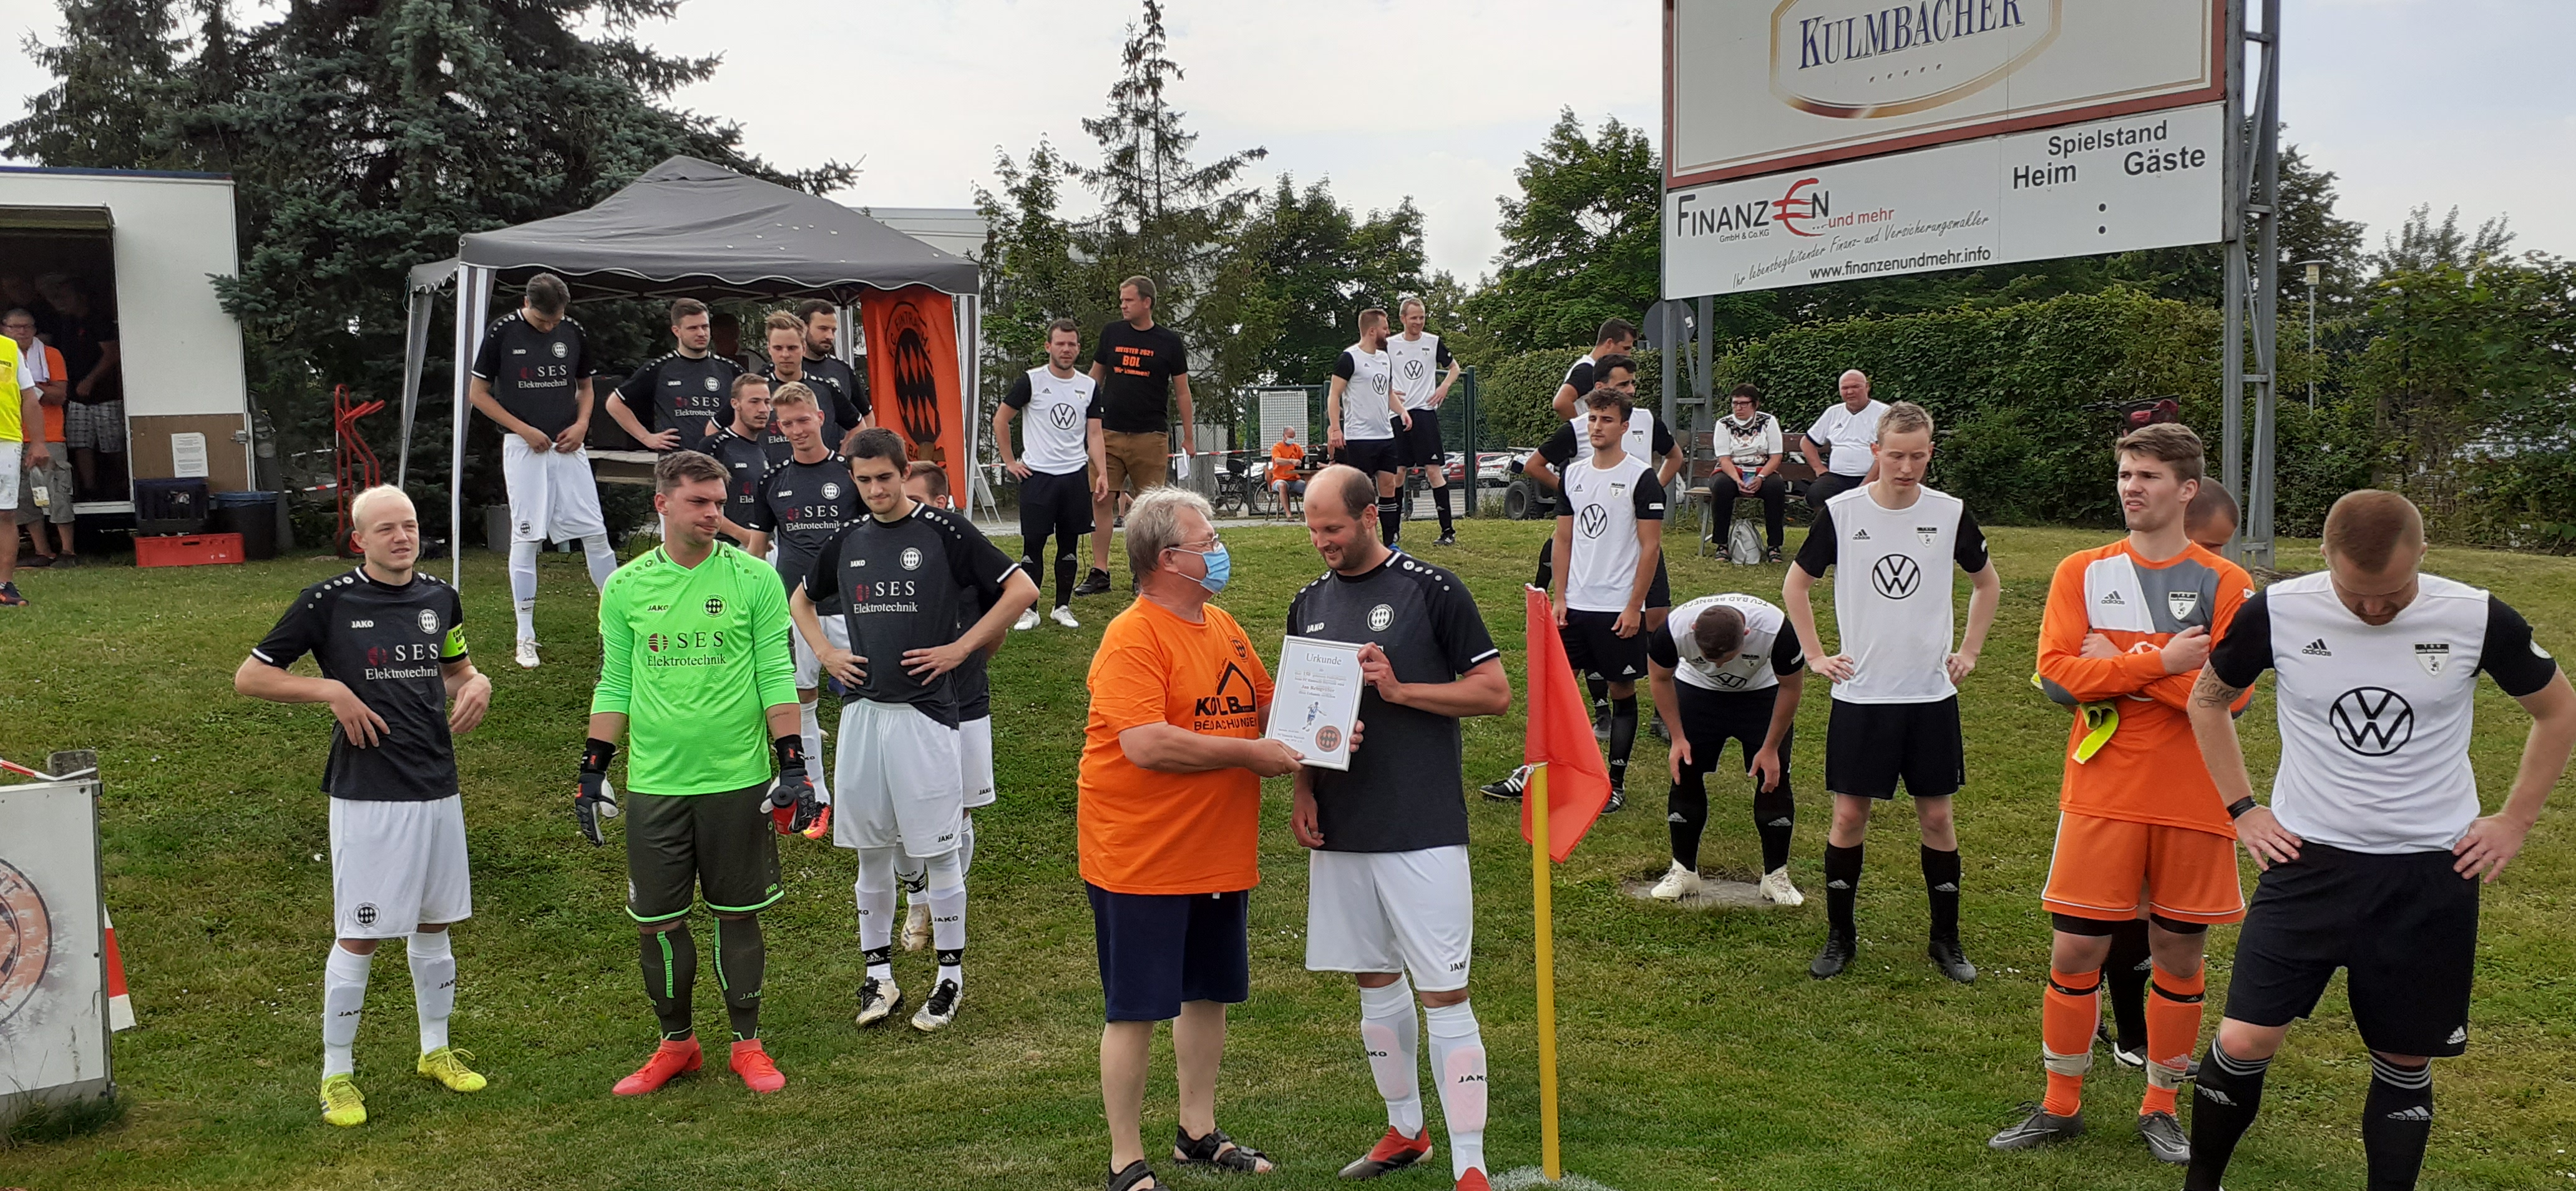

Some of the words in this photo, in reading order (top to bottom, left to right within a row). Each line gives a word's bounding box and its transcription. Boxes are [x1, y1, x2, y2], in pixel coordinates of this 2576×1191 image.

[1798, 0, 2026, 71] KULMBACHER
[2047, 119, 2168, 159] Spielstand
[2013, 161, 2077, 190] Heim
[2124, 145, 2206, 176] Gäste
[1857, 207, 1895, 224] mehr
[1719, 231, 1740, 243] GmbH
[1732, 273, 1746, 292] Ihr
[1749, 241, 1826, 281] lebensbegleitender
[1830, 236, 1861, 253] Finanz-
[1864, 231, 1880, 245] und
[1884, 209, 1990, 242] Versicherungsmakler
[1810, 246, 1991, 280] www.finanzenundmehr.info
[1139, 348, 1154, 357] 2021
[1122, 355, 1141, 367] BOL
[778, 490, 793, 498] JAKO
[850, 559, 866, 567] JAKO
[853, 601, 919, 614] Elektrotechnik
[351, 620, 374, 629] JAKO
[1305, 622, 1325, 634] JAKO
[1305, 652, 1342, 666] Urkunde
[2301, 647, 2332, 657] adidas
[647, 653, 728, 667] Elektrotechnik
[364, 665, 438, 680] Elektrotechni
[1194, 696, 1239, 717] KOLB
[1194, 717, 1257, 731] BEDACHUNGE
[937, 833, 954, 843] JAKO
